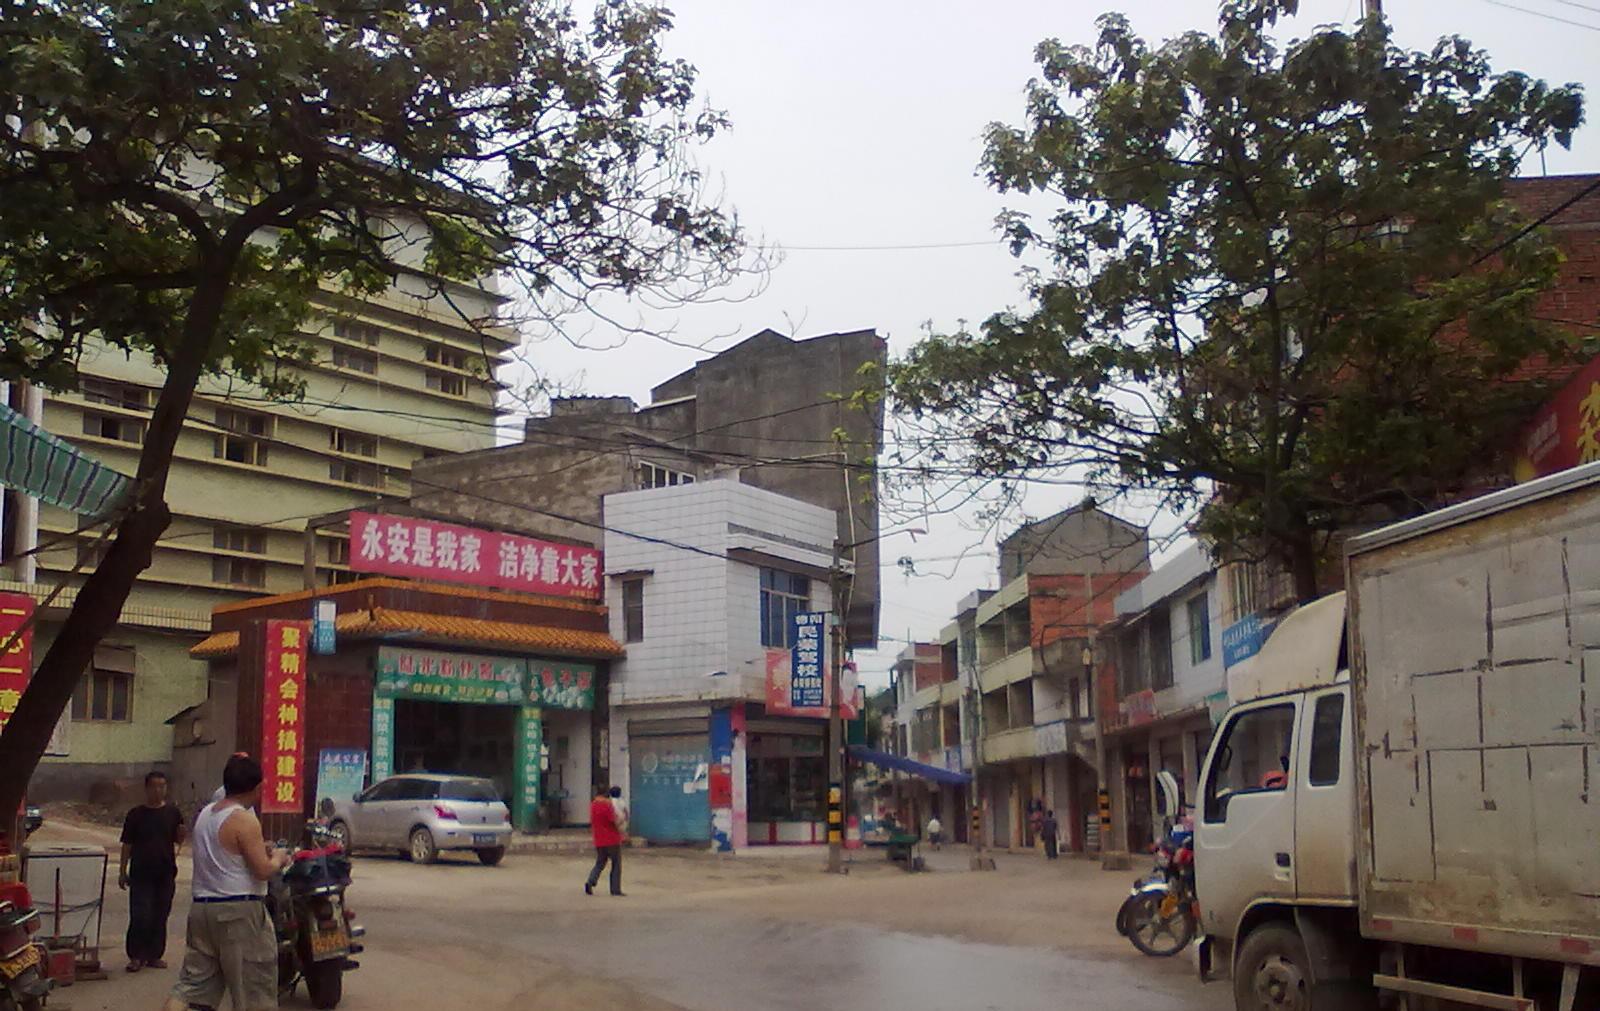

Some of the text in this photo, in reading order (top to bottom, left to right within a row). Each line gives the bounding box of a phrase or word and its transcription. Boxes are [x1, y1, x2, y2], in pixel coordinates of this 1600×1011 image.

[361, 518, 599, 589] 永安是我家 洁净靠大家
[0, 607, 26, 734] 一心一意
[275, 626, 301, 803] 聚精会神搞建设
